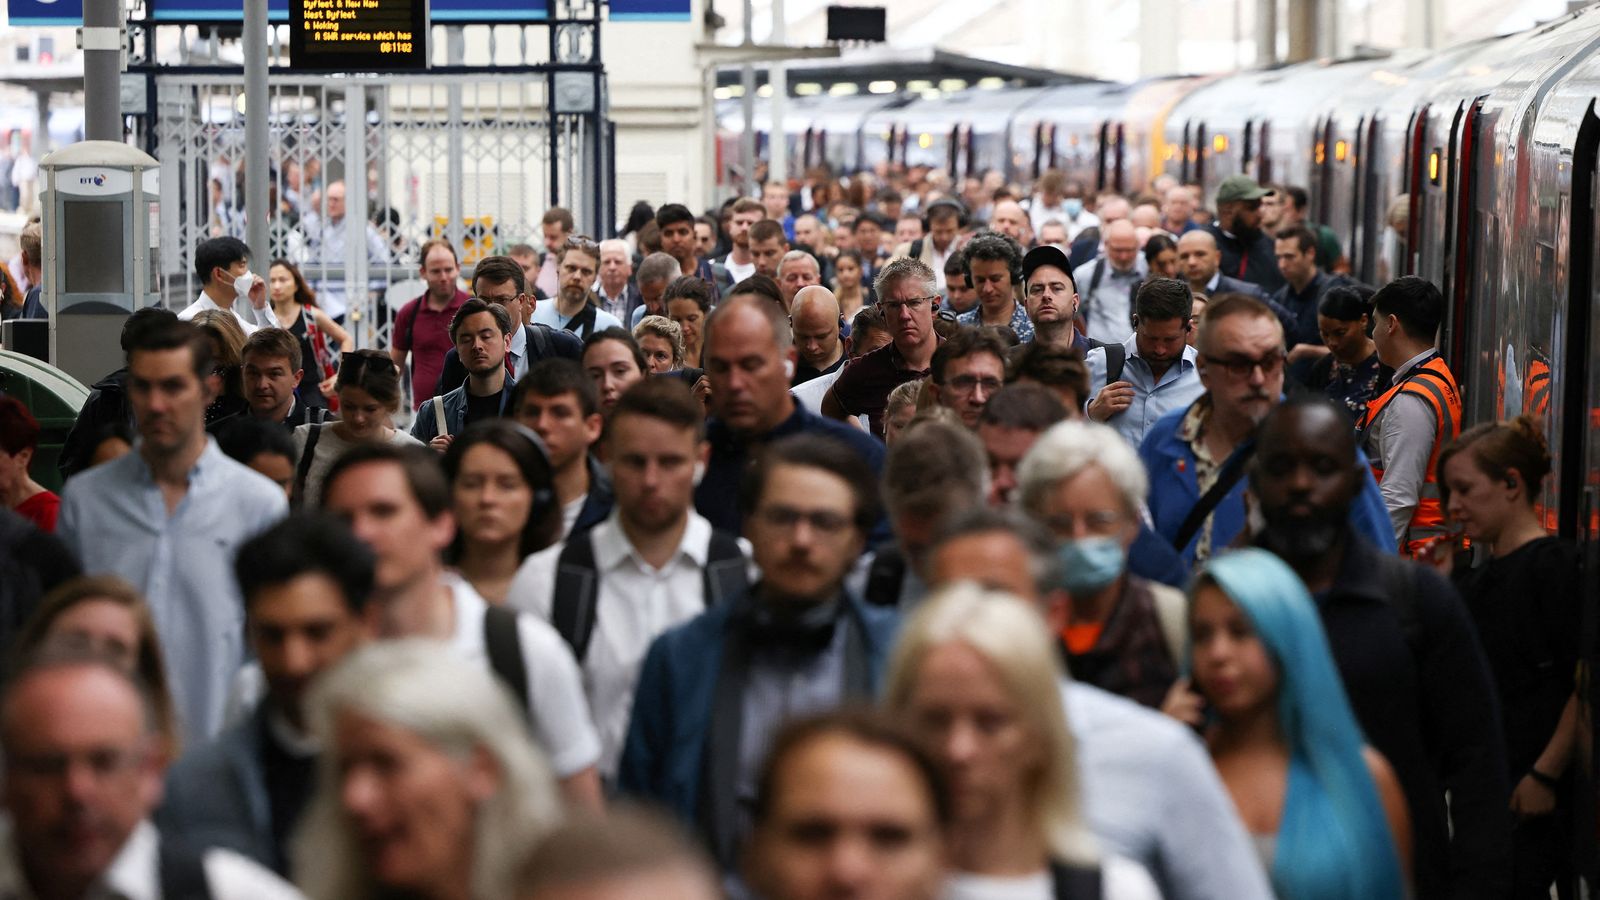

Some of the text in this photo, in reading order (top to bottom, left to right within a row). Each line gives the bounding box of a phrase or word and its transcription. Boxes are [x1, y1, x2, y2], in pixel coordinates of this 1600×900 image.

[303, 0, 378, 10] Byfleet & New Haw
[303, 10, 356, 20] West Byfleet
[304, 21, 339, 31] & Woking
[315, 31, 412, 40] A SWR service which has
